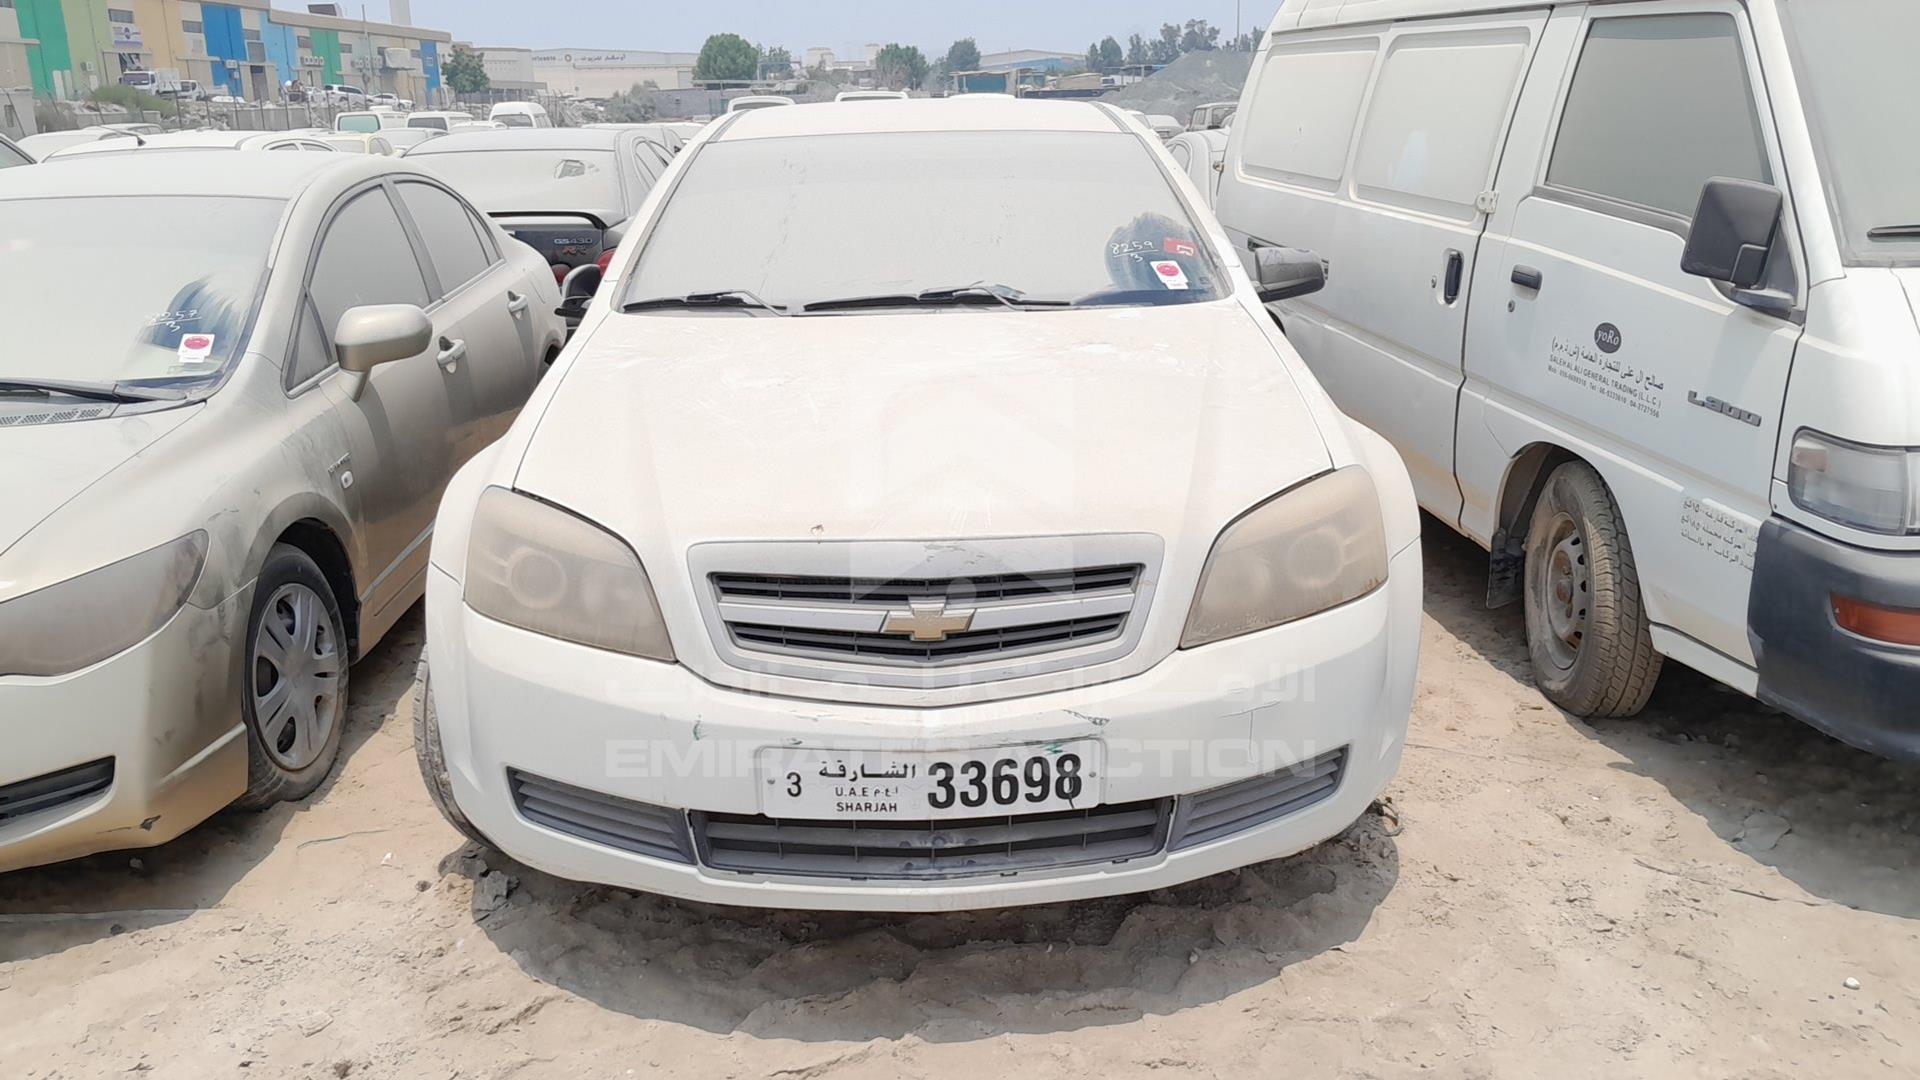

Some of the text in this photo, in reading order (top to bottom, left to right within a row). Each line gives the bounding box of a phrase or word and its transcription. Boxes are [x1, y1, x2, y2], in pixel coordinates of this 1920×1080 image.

[1110, 240, 1154, 255] 8259
[1583, 368, 1610, 386] GENERAL
[1611, 379, 1638, 398] TRADING
[819, 759, 916, 782] الشارقة
[927, 753, 1083, 810] 33698
[786, 772, 802, 797] 3
[836, 802, 898, 813] SHARJAH
